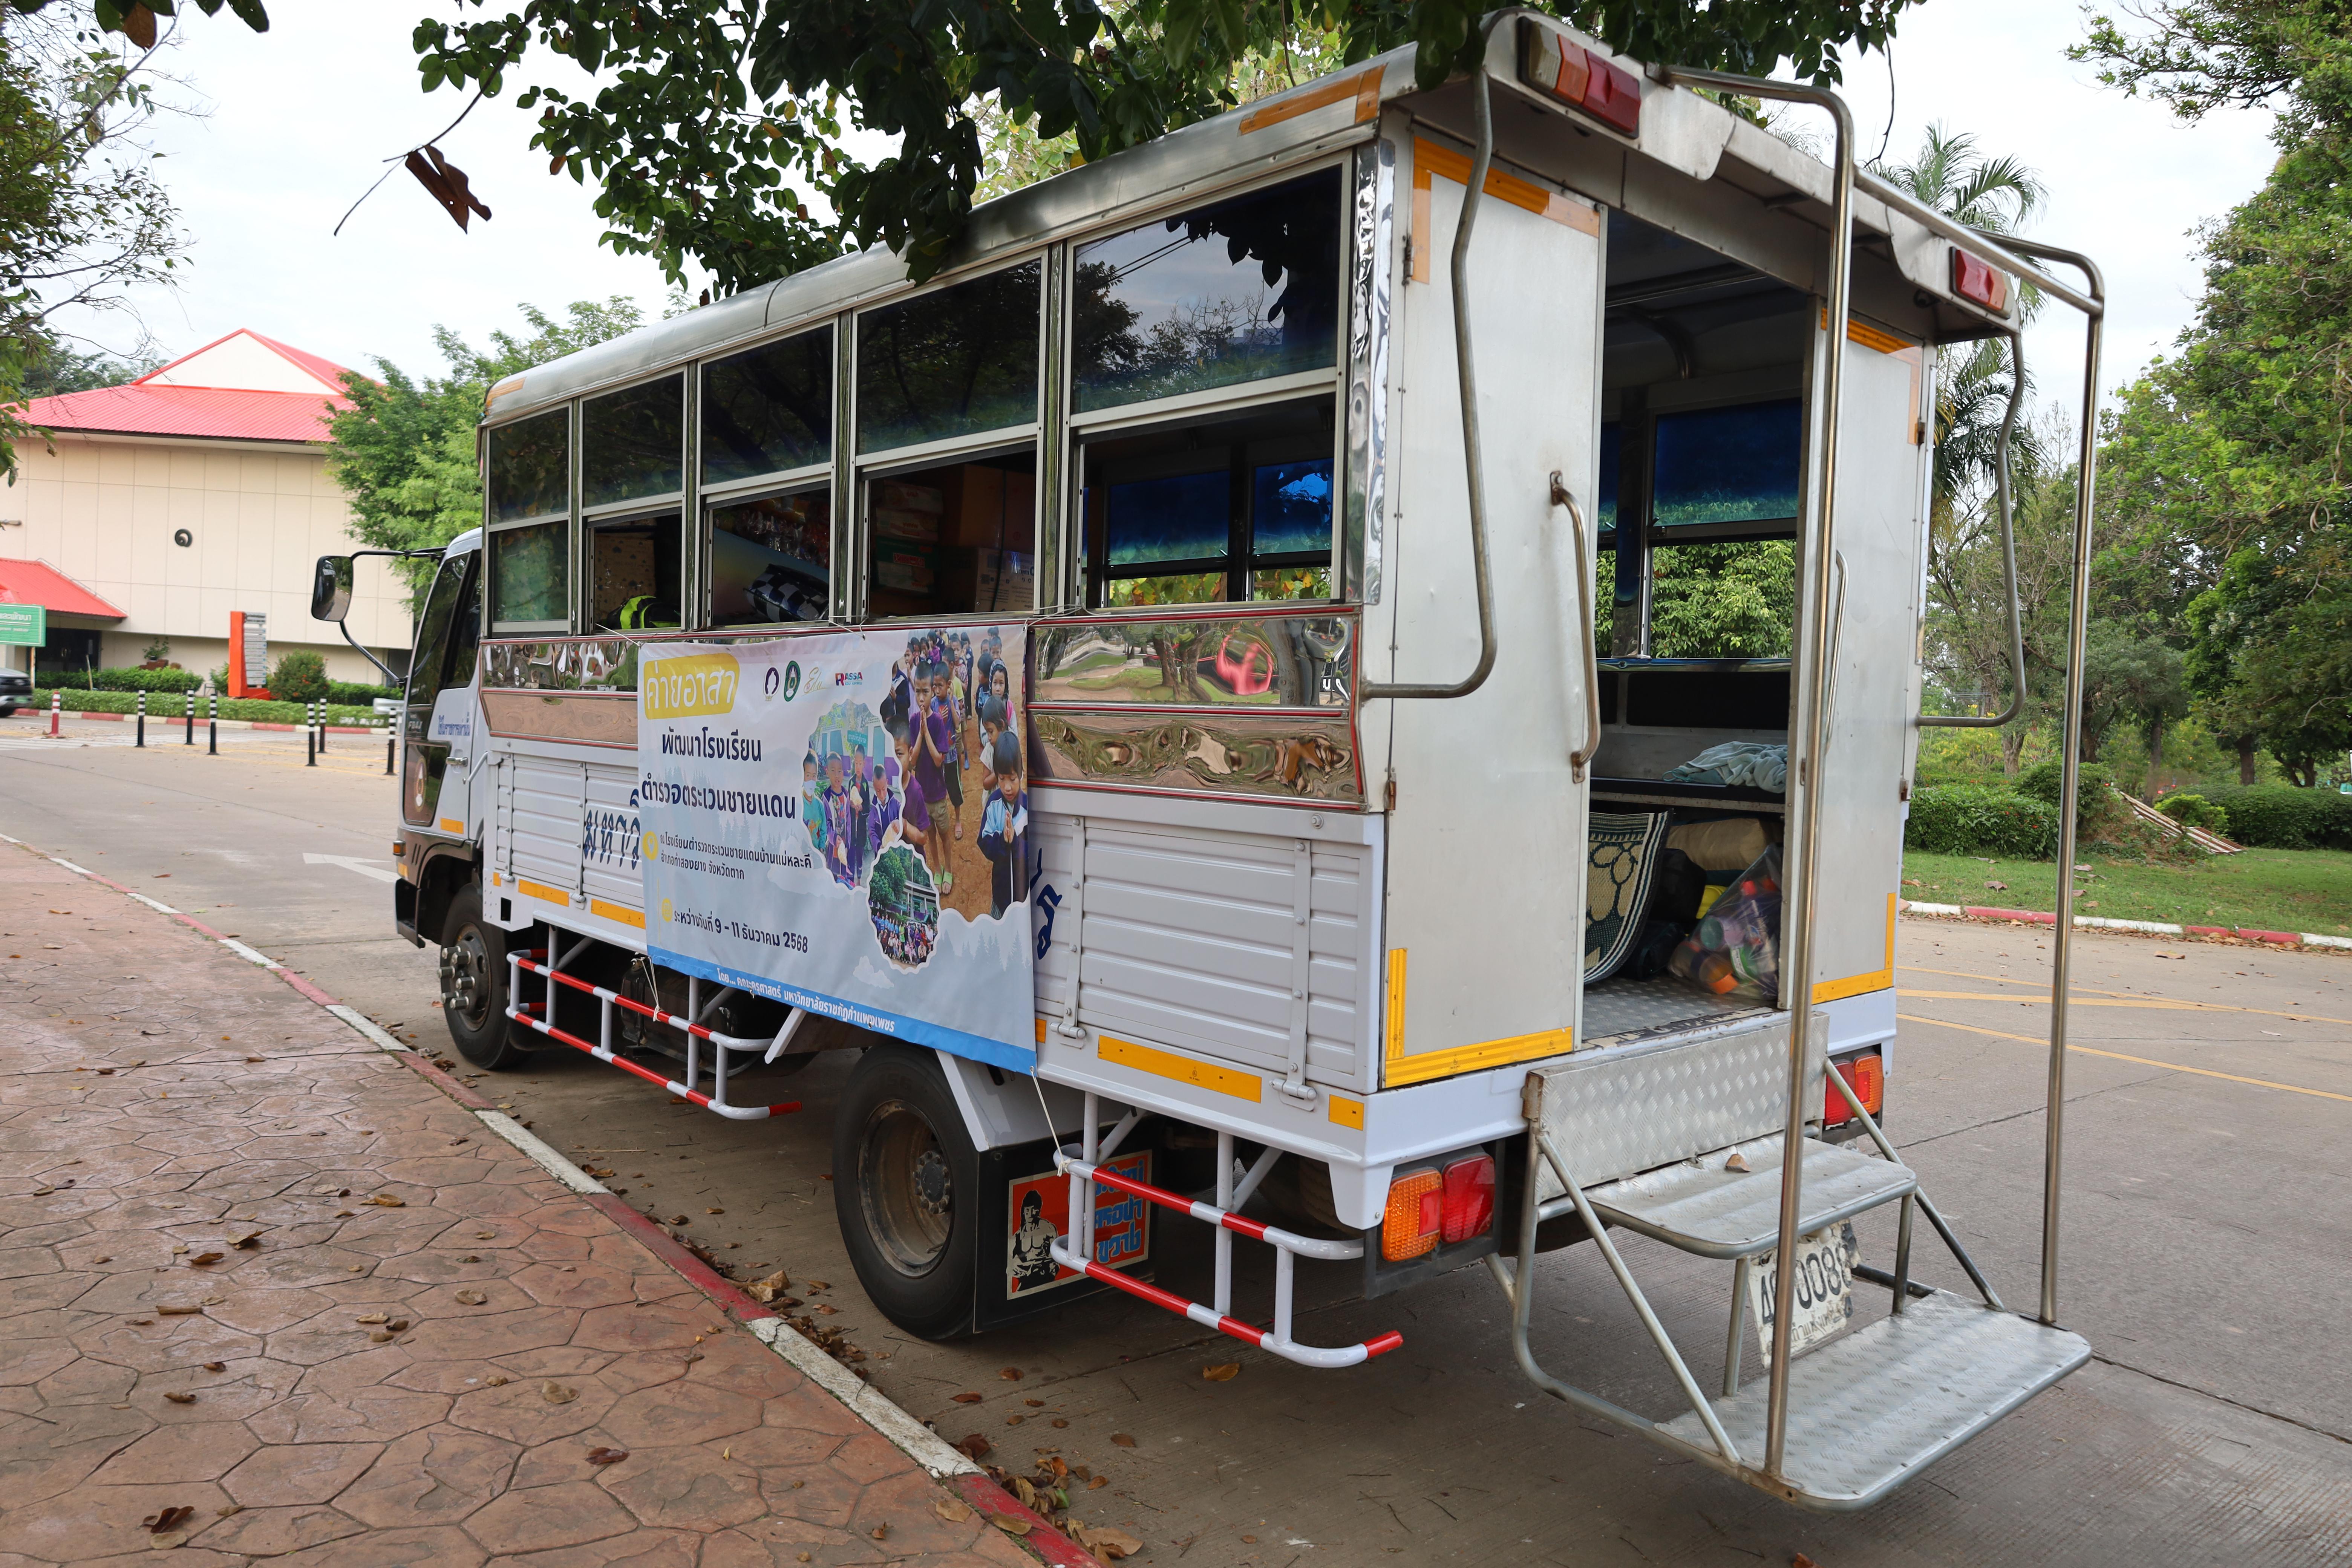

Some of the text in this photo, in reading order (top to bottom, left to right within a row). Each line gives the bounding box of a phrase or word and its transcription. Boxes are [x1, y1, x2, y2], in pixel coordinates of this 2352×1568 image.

[646, 661, 735, 709] ค่ายอาสา
[662, 726, 761, 761] พัฒนาโรงเรียน
[642, 772, 796, 819] ตำรวจตระเวนชายแดน
[661, 849, 744, 880] อำเภอท่าสองยาง จังหวัดตาก
[674, 908, 714, 932] ระหว่างวันที่
[715, 918, 721, 934] 9
[731, 921, 740, 938] 11
[742, 922, 780, 946] ธันวาคม
[782, 931, 808, 954] 2568
